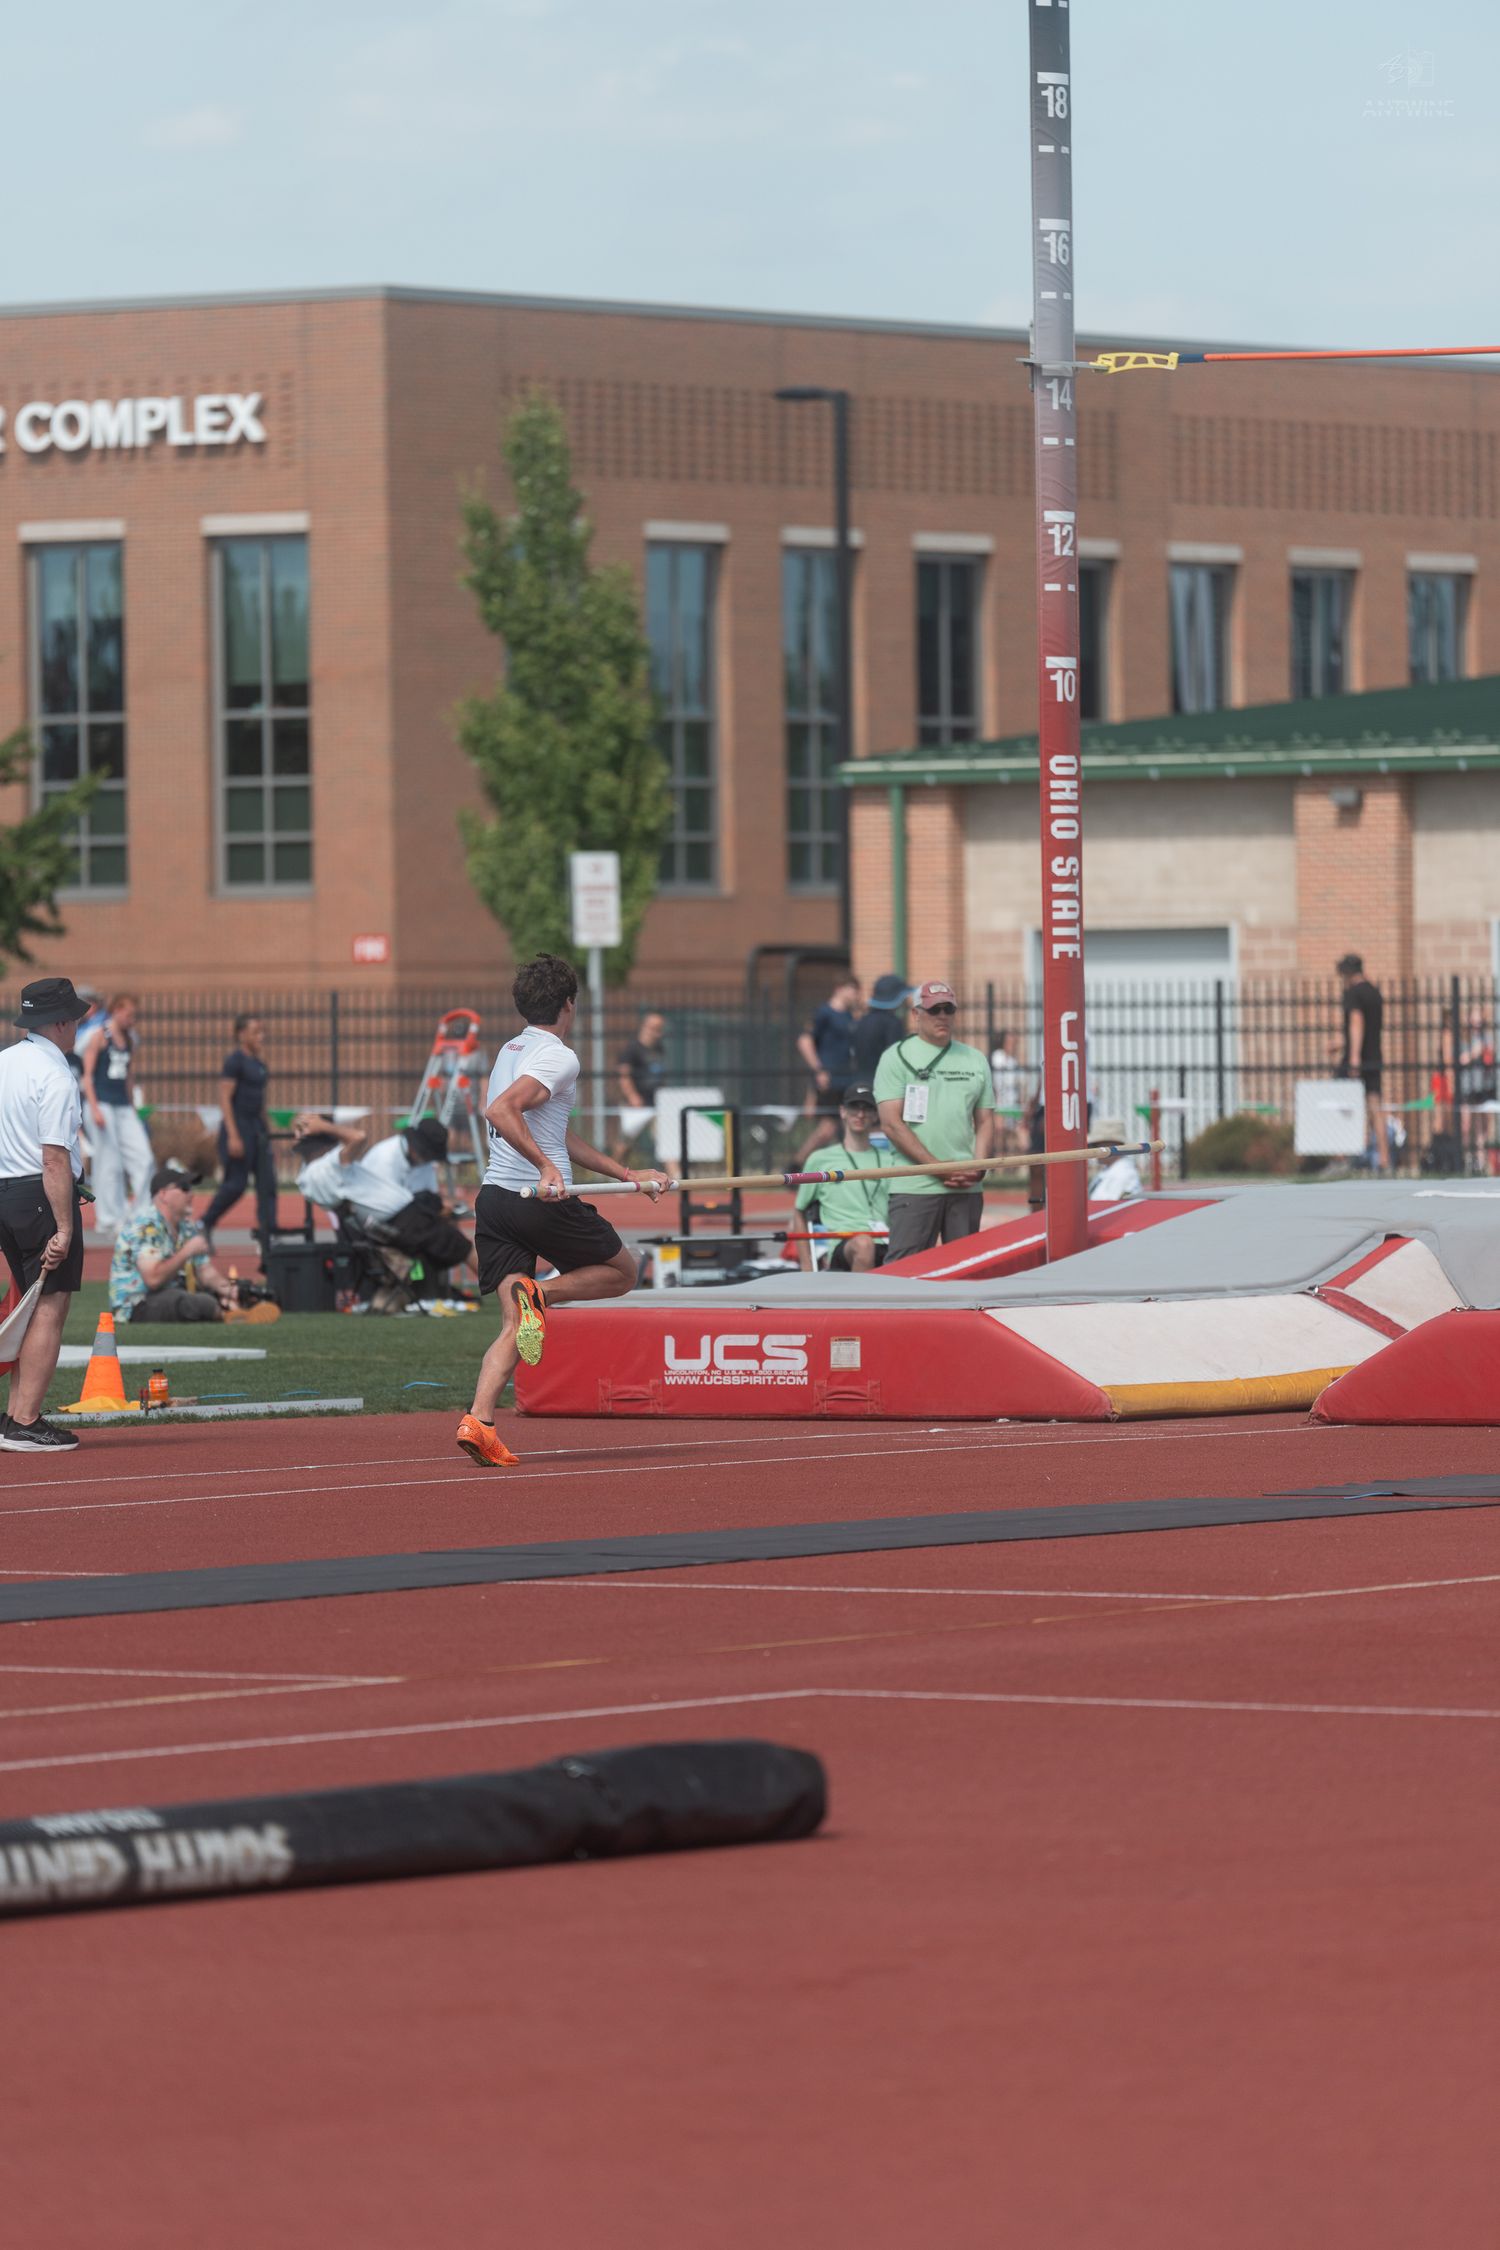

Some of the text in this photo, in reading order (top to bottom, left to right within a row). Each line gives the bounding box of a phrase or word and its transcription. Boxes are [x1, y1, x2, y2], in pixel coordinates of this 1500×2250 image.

[1040, 85, 1069, 119] 18
[1043, 231, 1071, 265] 16
[1046, 378, 1073, 411] 14
[15, 391, 267, 453] COMPLEX
[1047, 523, 1075, 557] 12
[1050, 669, 1077, 703] 10
[1049, 754, 1081, 960] OHIO STATE
[1060, 1011, 1081, 1132] UCS
[664, 1334, 808, 1371] UCS
[664, 1375, 808, 1386] WWW.UCSSPIRIT.COM
